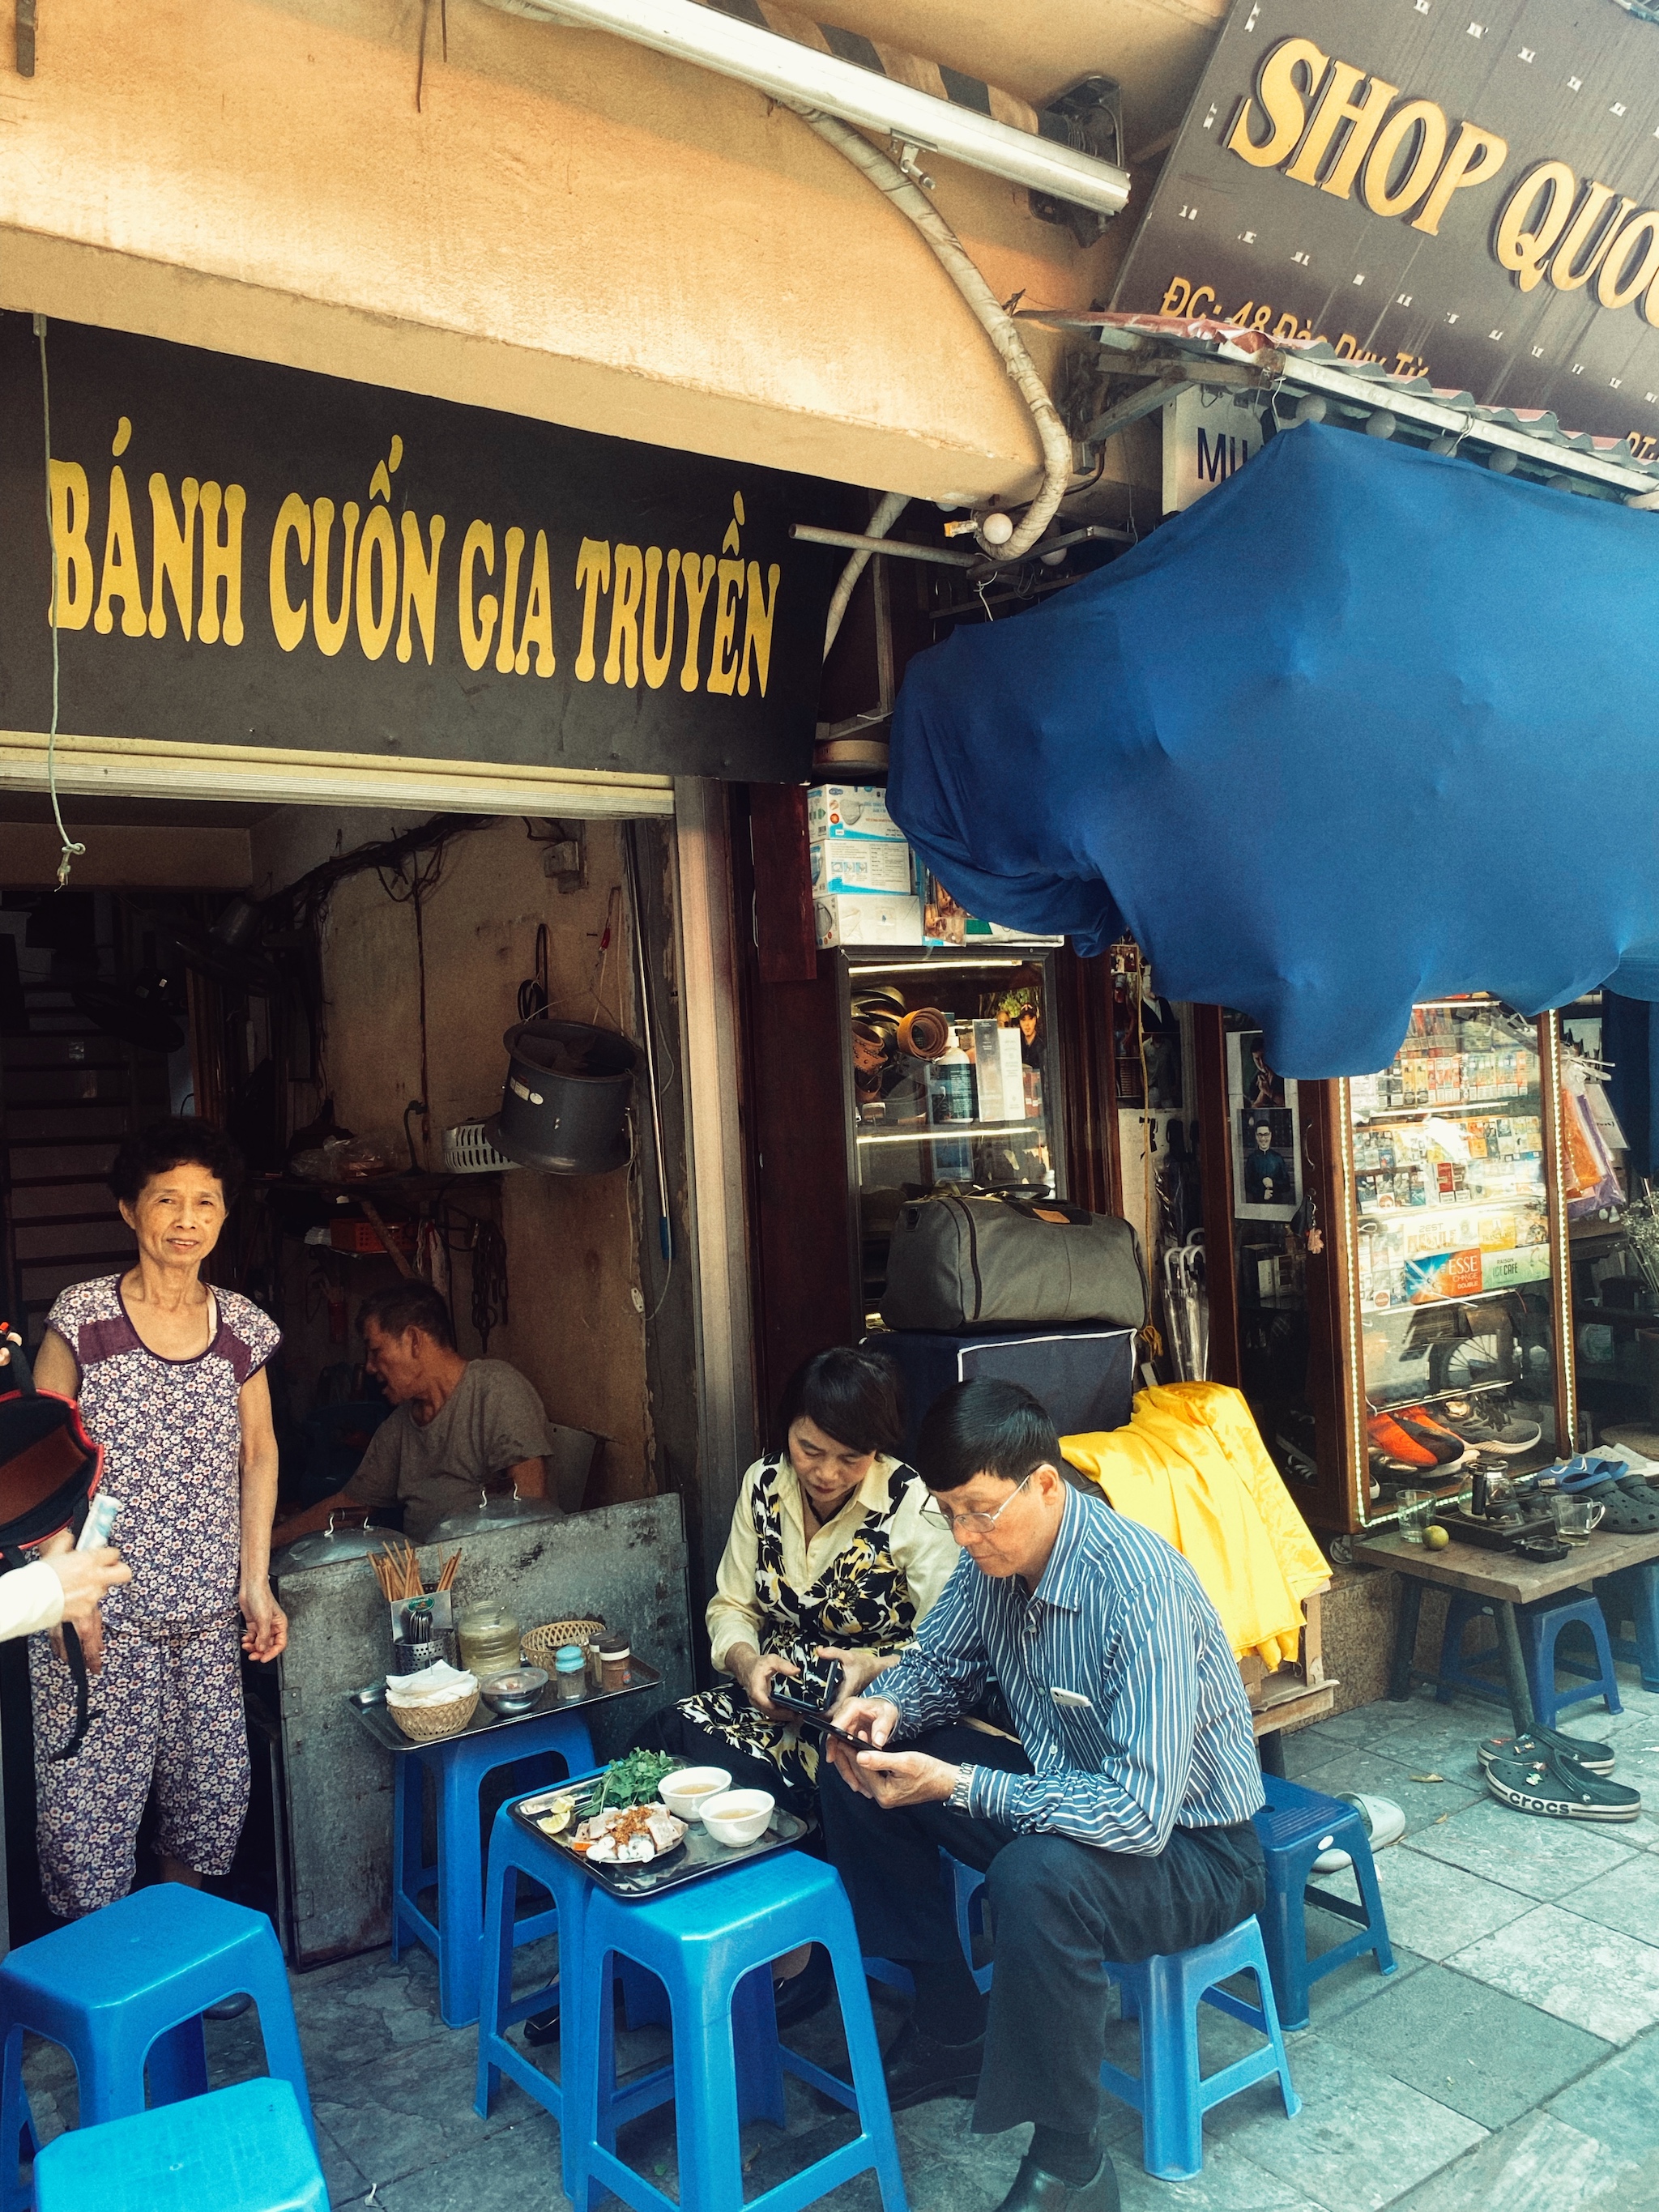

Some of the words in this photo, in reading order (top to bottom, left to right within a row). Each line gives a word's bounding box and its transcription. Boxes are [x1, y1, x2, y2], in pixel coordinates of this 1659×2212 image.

[1226, 37, 1508, 237] SHOP
[1232, 300, 1272, 331] 48
[48, 416, 246, 646] BÁNH
[270, 434, 446, 665] CUỐN
[459, 519, 556, 678] GIA
[574, 490, 780, 697] TRUYỀN
[1418, 1222, 1444, 1233] ZEST
[1448, 1255, 1478, 1276] ESSE
[1457, 1281, 1478, 1289] DOUBLE
[1537, 1477, 1555, 1487] NIKE
[1509, 1792, 1569, 1814] crocs
